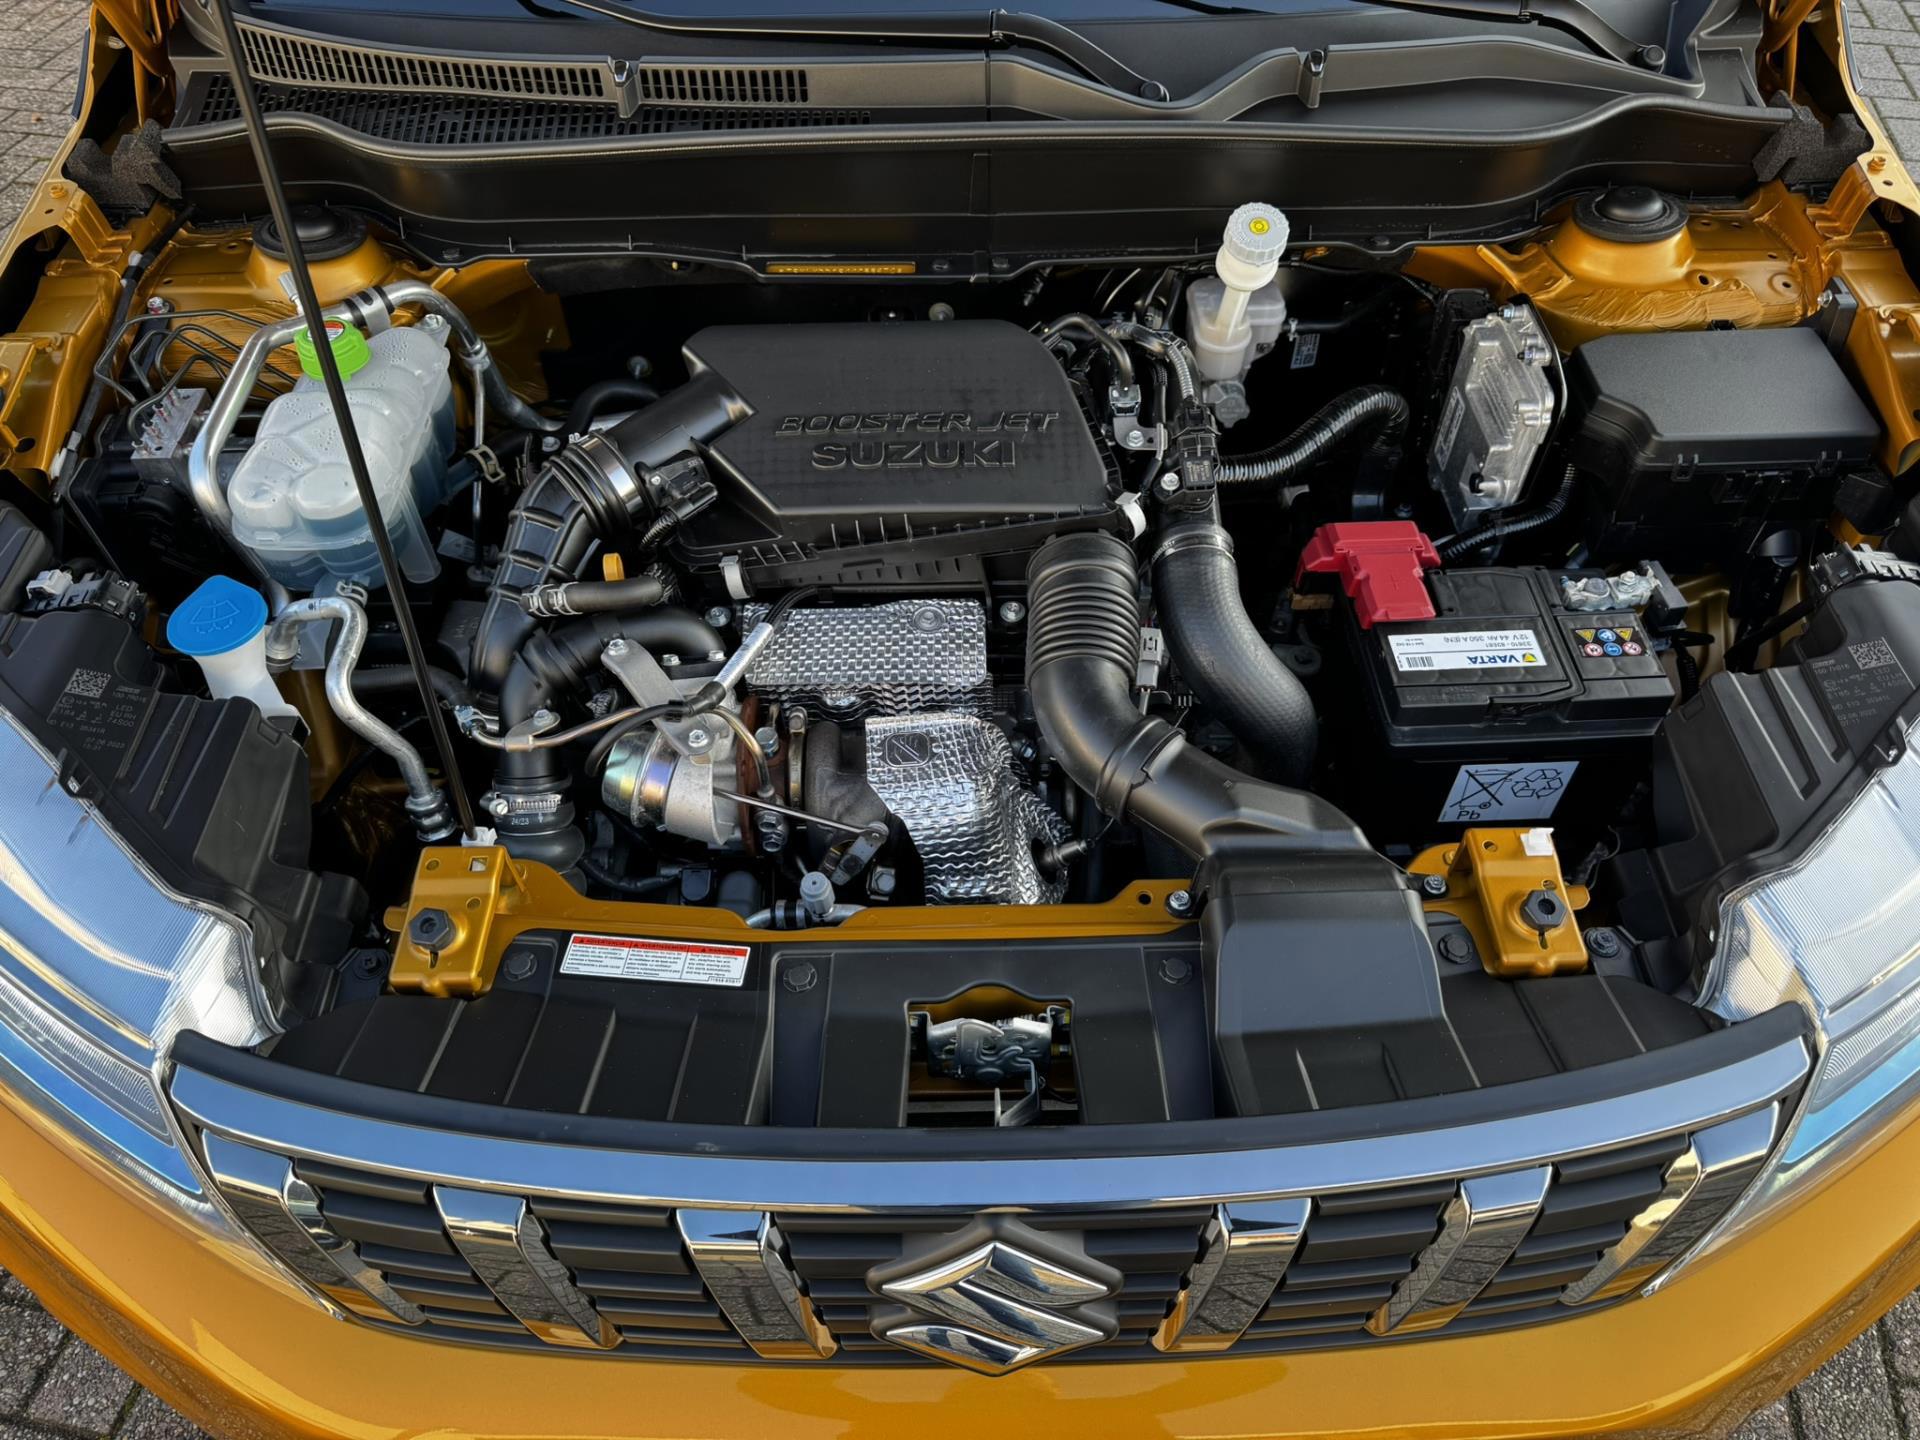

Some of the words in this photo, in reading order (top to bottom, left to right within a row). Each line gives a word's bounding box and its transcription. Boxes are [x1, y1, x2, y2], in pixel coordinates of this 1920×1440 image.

[812, 440, 1016, 469] SUZUKI
[1467, 654, 1521, 665] VARTA
[1457, 810, 1480, 819] Pb
